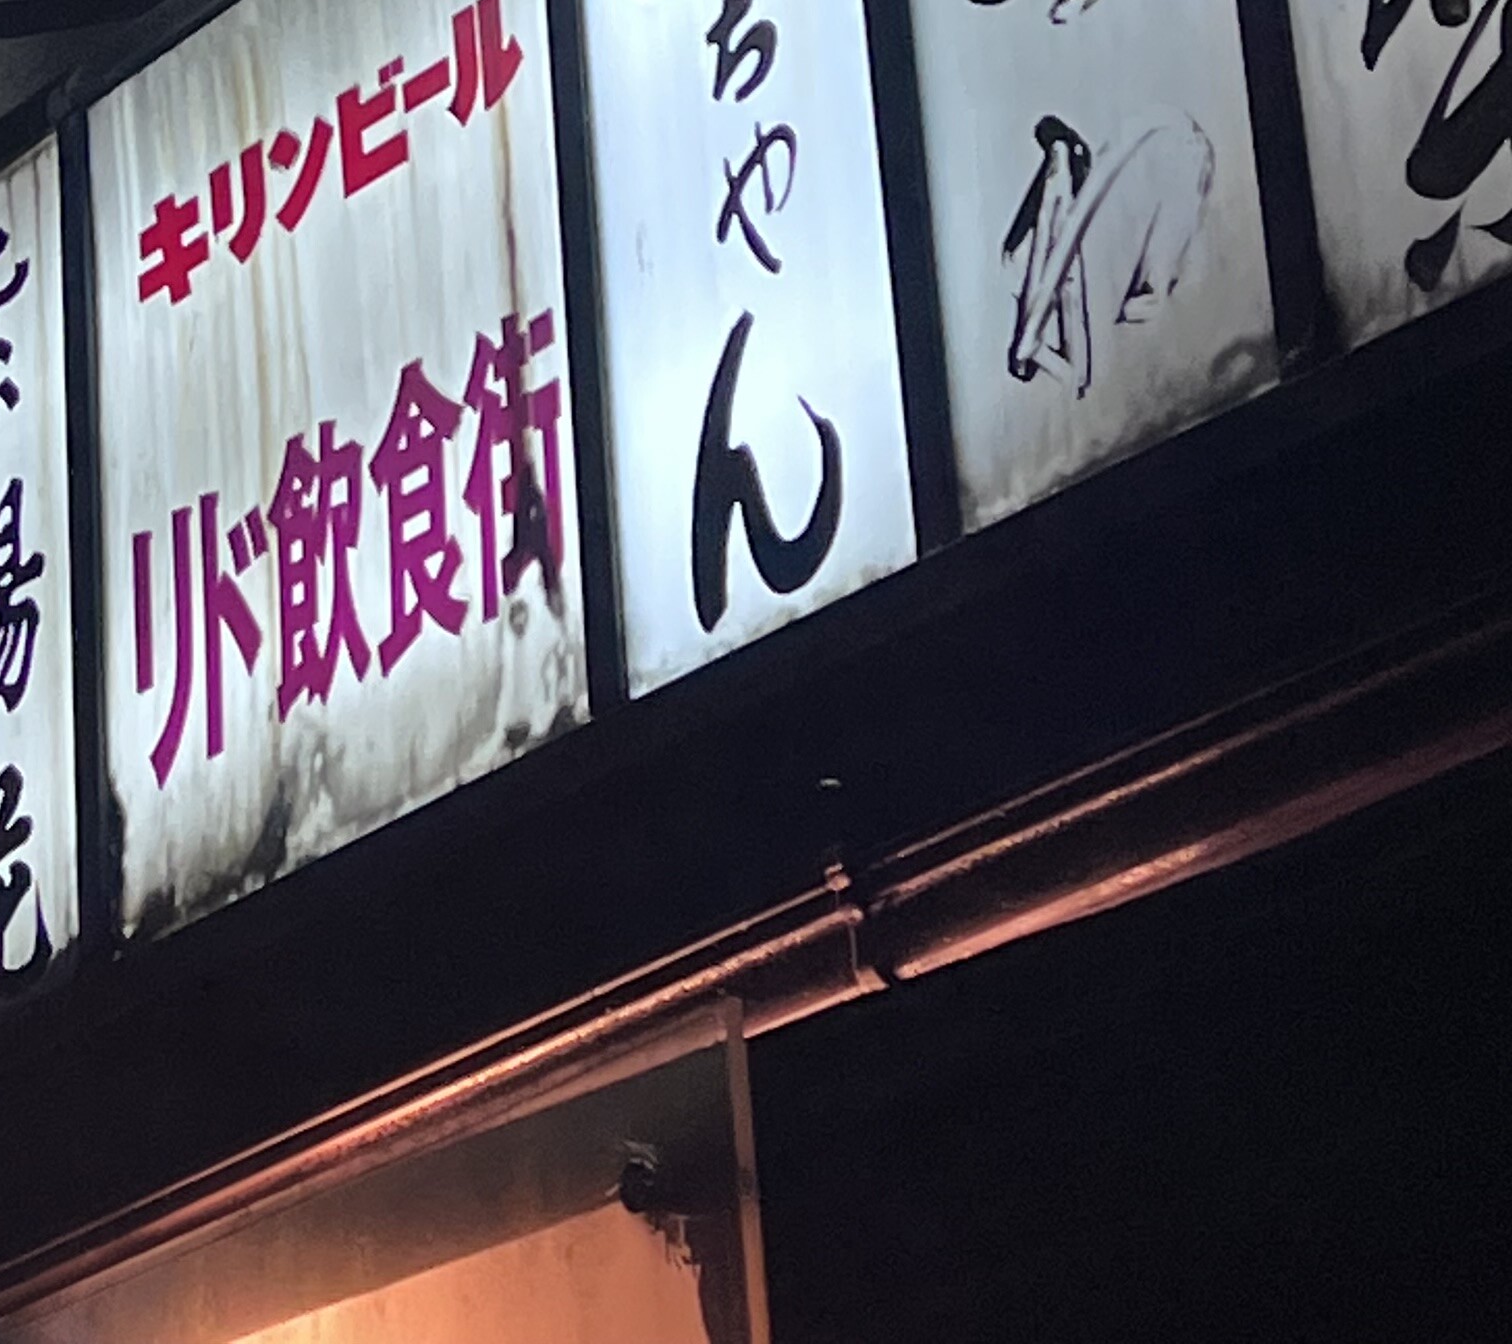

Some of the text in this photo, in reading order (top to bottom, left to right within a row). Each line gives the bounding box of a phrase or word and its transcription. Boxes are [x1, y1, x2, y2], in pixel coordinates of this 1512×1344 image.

[133, 308, 562, 788] リド飲食街
